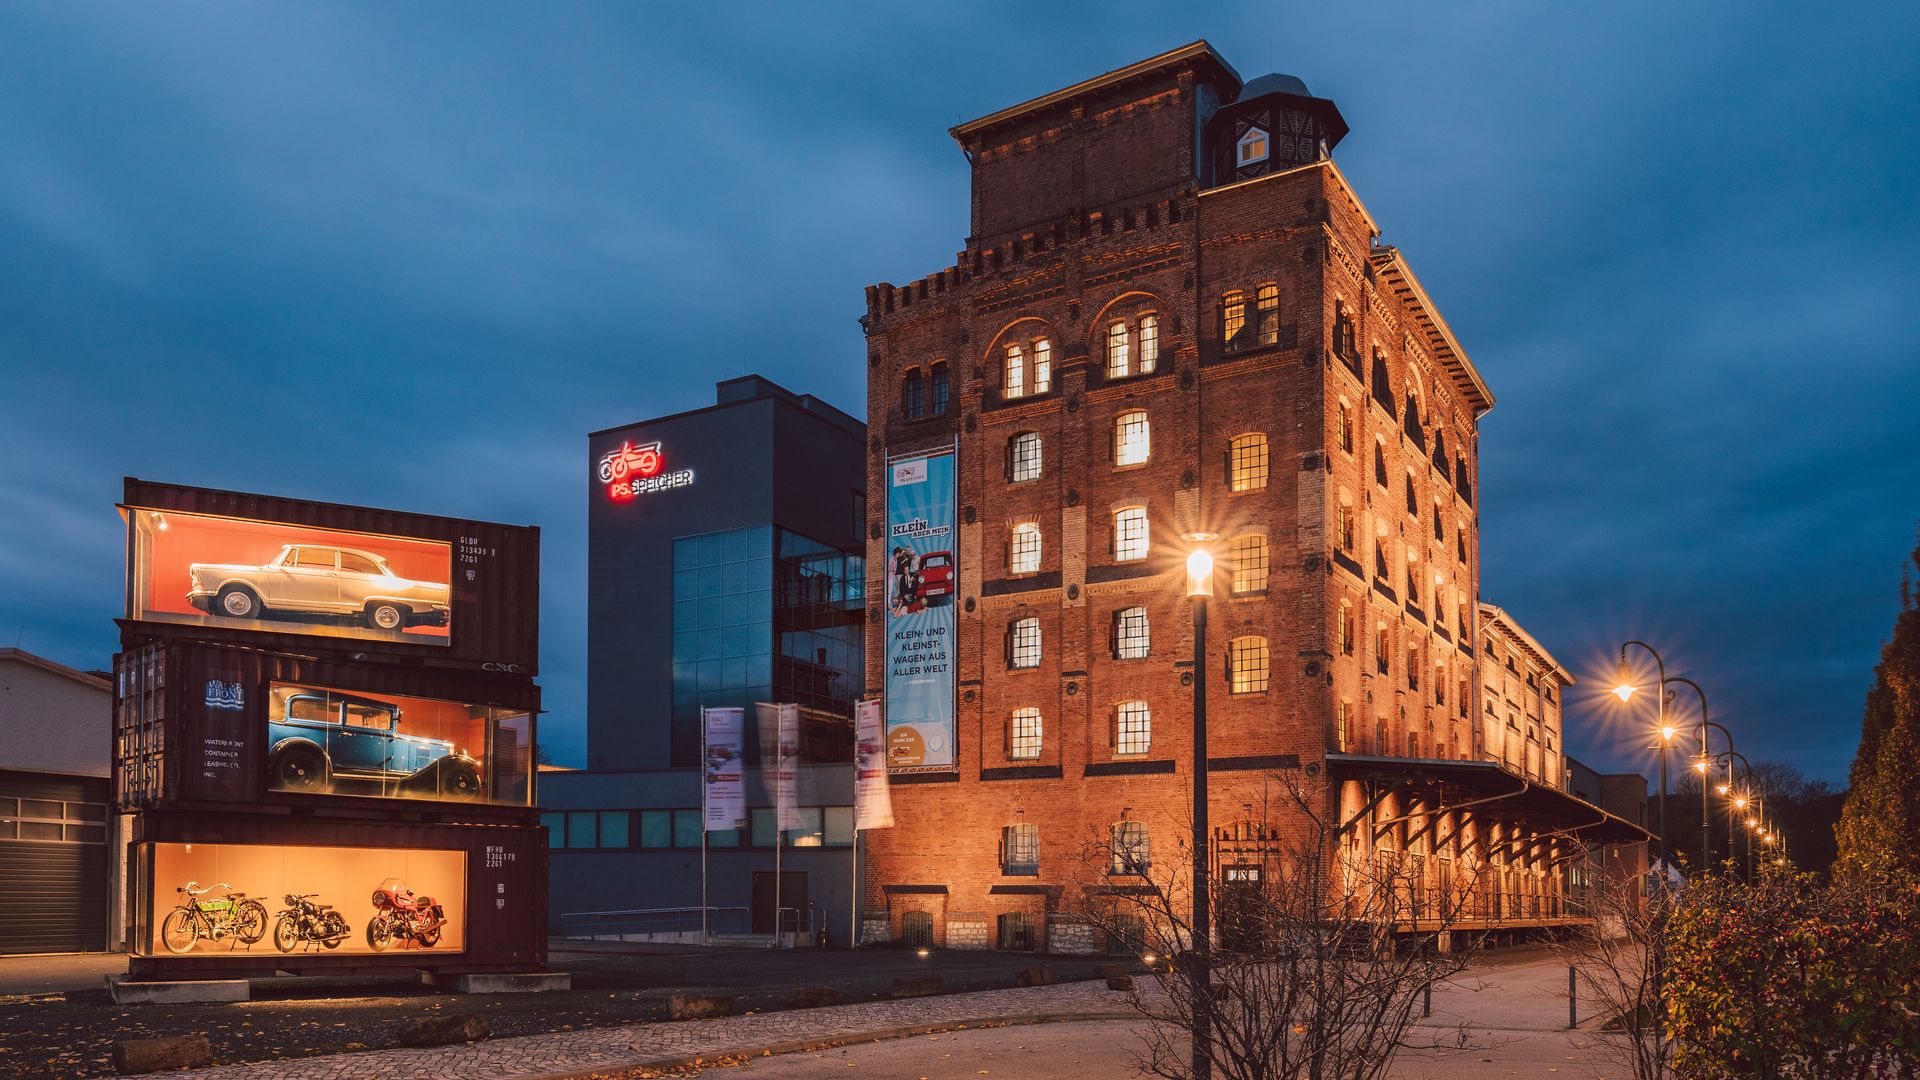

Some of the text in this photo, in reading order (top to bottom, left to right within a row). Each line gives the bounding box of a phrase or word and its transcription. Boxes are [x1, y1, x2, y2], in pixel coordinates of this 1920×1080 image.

[612, 471, 693, 497] PS.SPEICHER
[932, 527, 949, 536] MEIN
[895, 628, 945, 640] KLEIN- UND
[901, 641, 941, 651] KLEINST-
[893, 652, 947, 664] WAGEN AUS
[893, 664, 948, 676] ALLER WELT
[208, 689, 242, 701] FRONT
